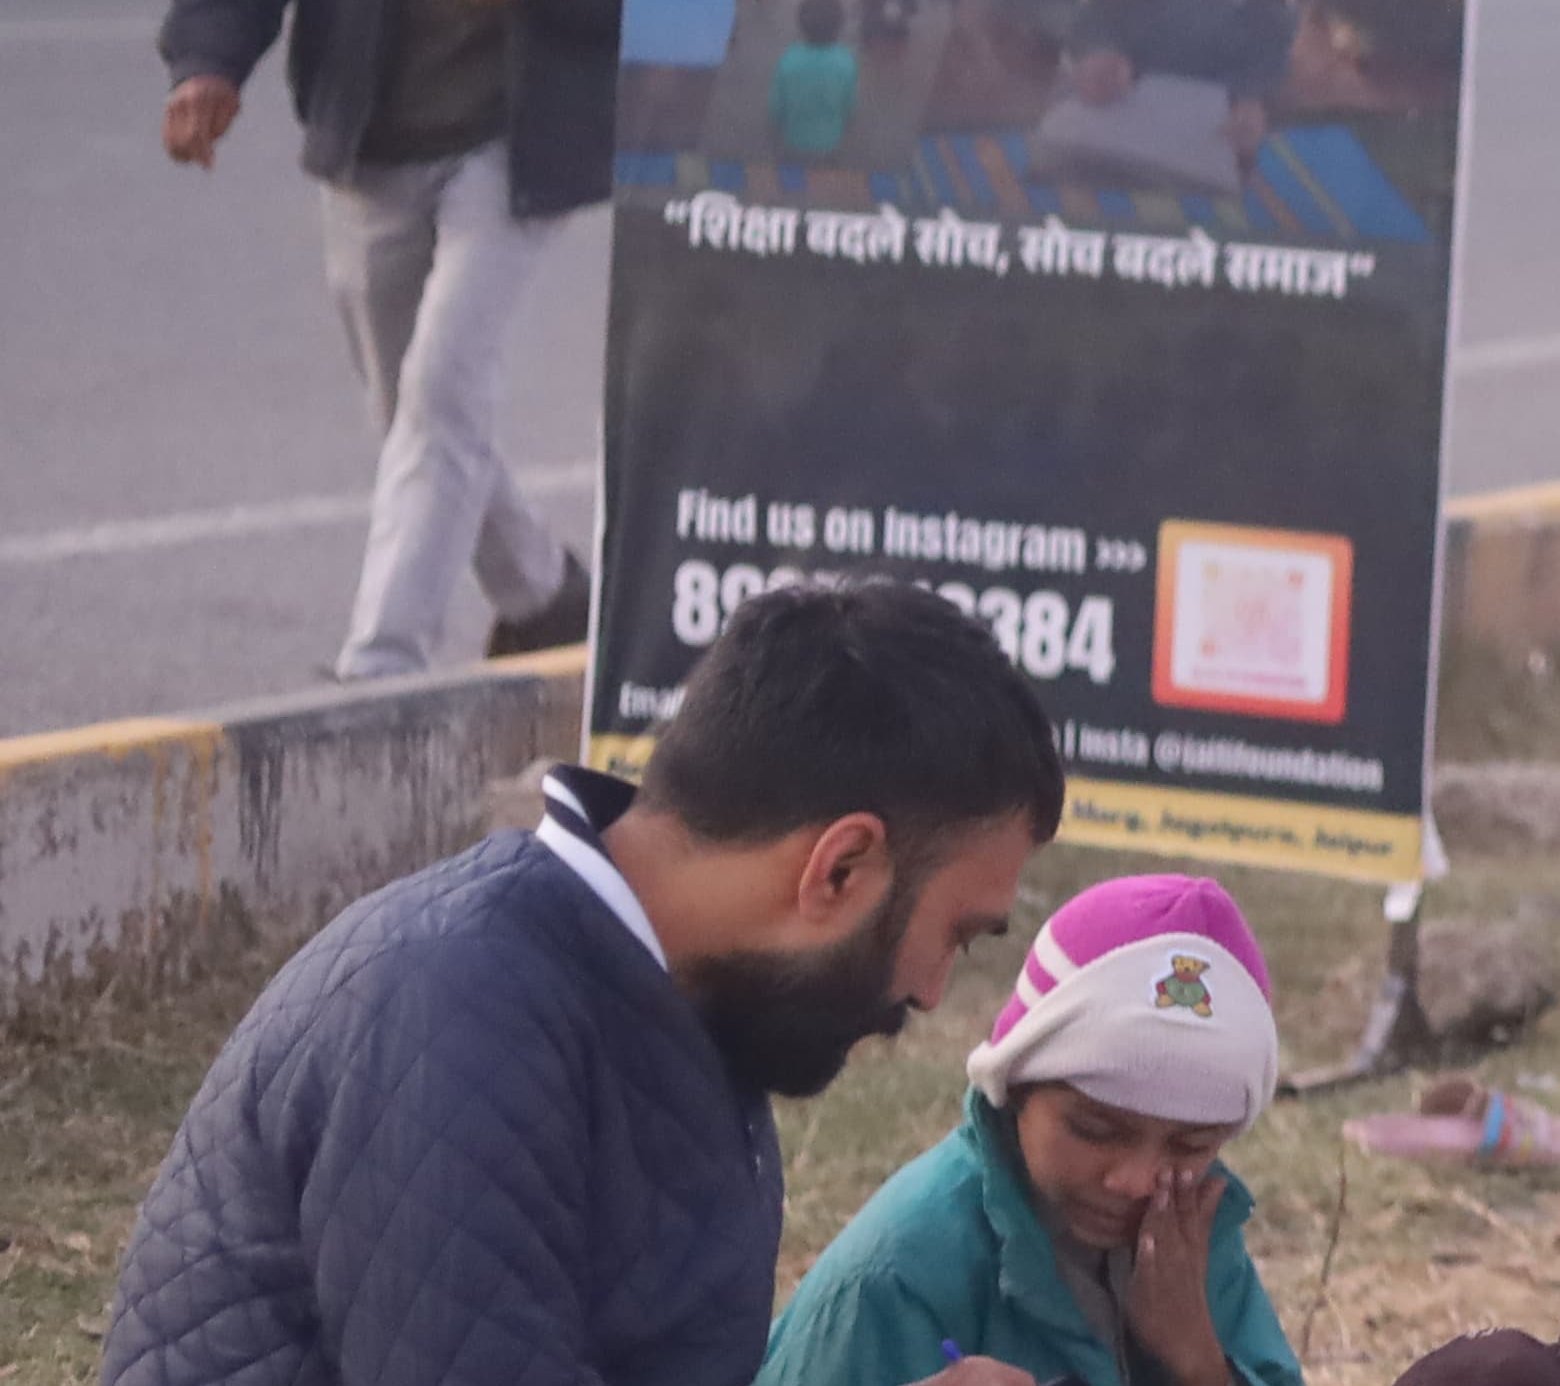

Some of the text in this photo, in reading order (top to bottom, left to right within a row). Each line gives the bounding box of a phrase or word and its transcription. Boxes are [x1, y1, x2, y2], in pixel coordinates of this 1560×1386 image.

[676, 489, 758, 544] Find
[766, 502, 816, 549] us
[823, 507, 875, 554] on
[883, 507, 1088, 574] Instagram
